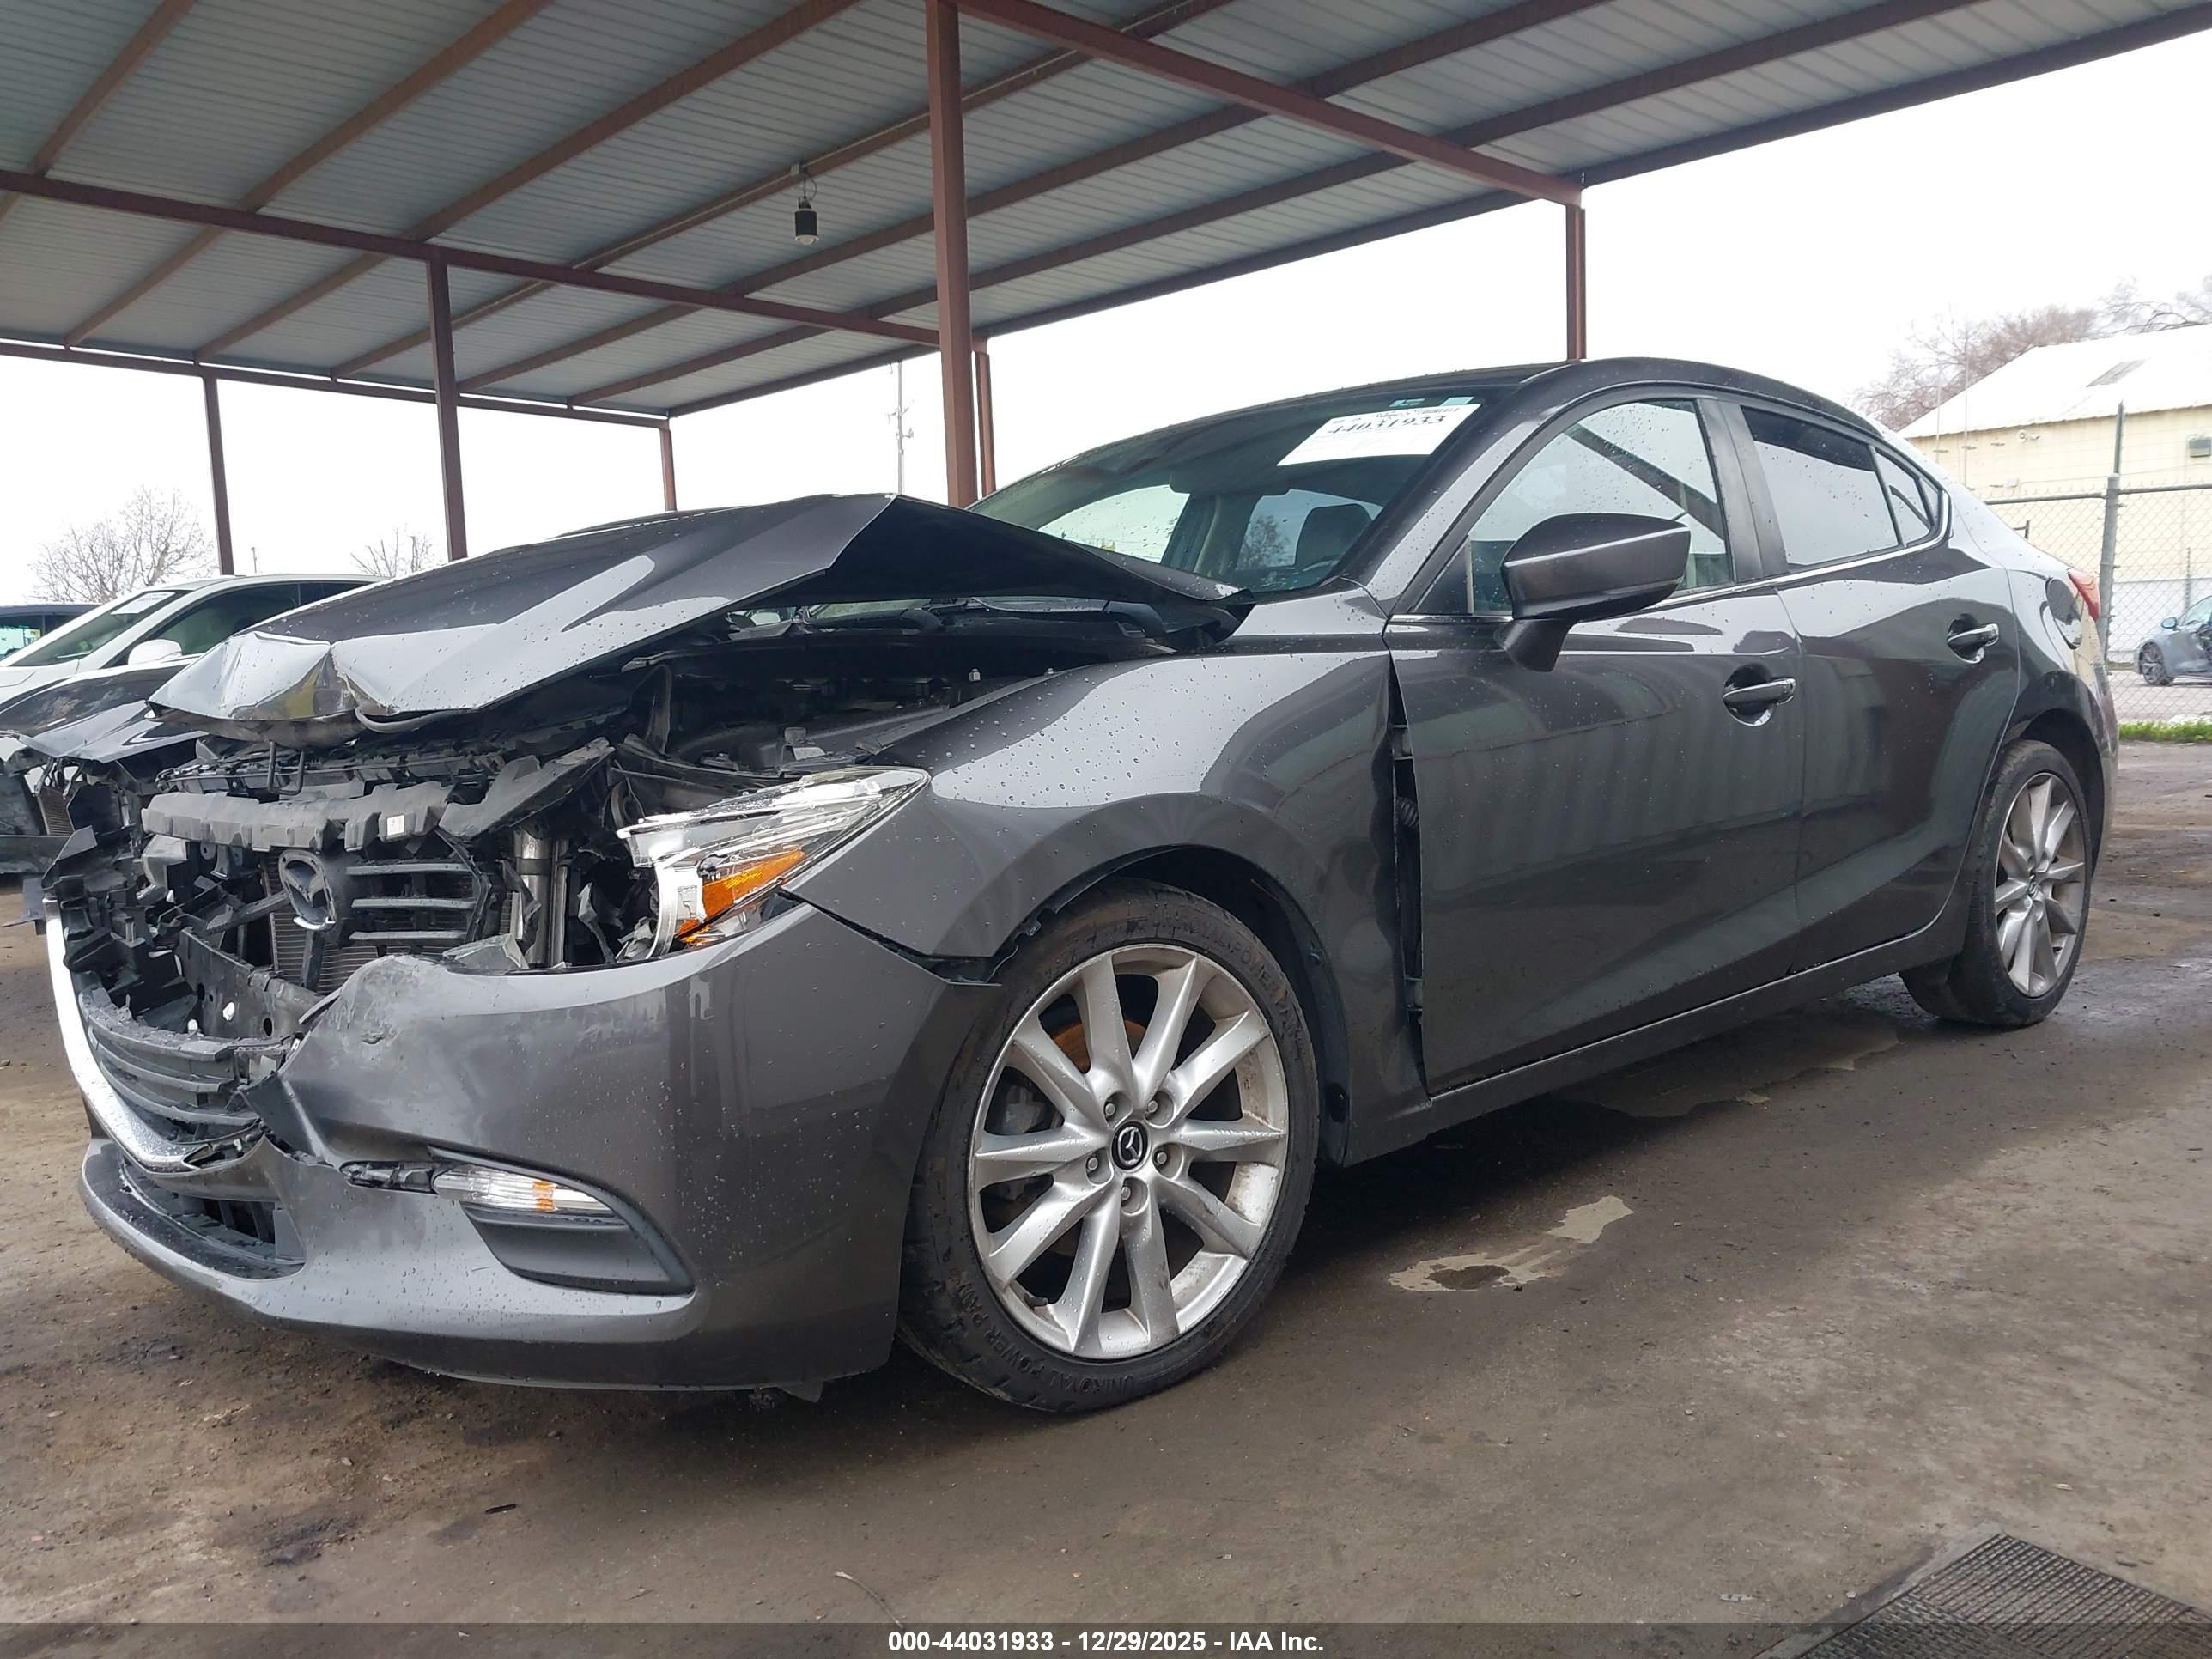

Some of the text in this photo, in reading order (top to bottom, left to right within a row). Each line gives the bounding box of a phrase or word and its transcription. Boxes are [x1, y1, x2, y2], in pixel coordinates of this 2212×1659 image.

[1328, 415, 1446, 434] 44031933
[984, 1323, 1045, 1378] POWER
[1048, 1367, 1135, 1395] UNIROYAL
